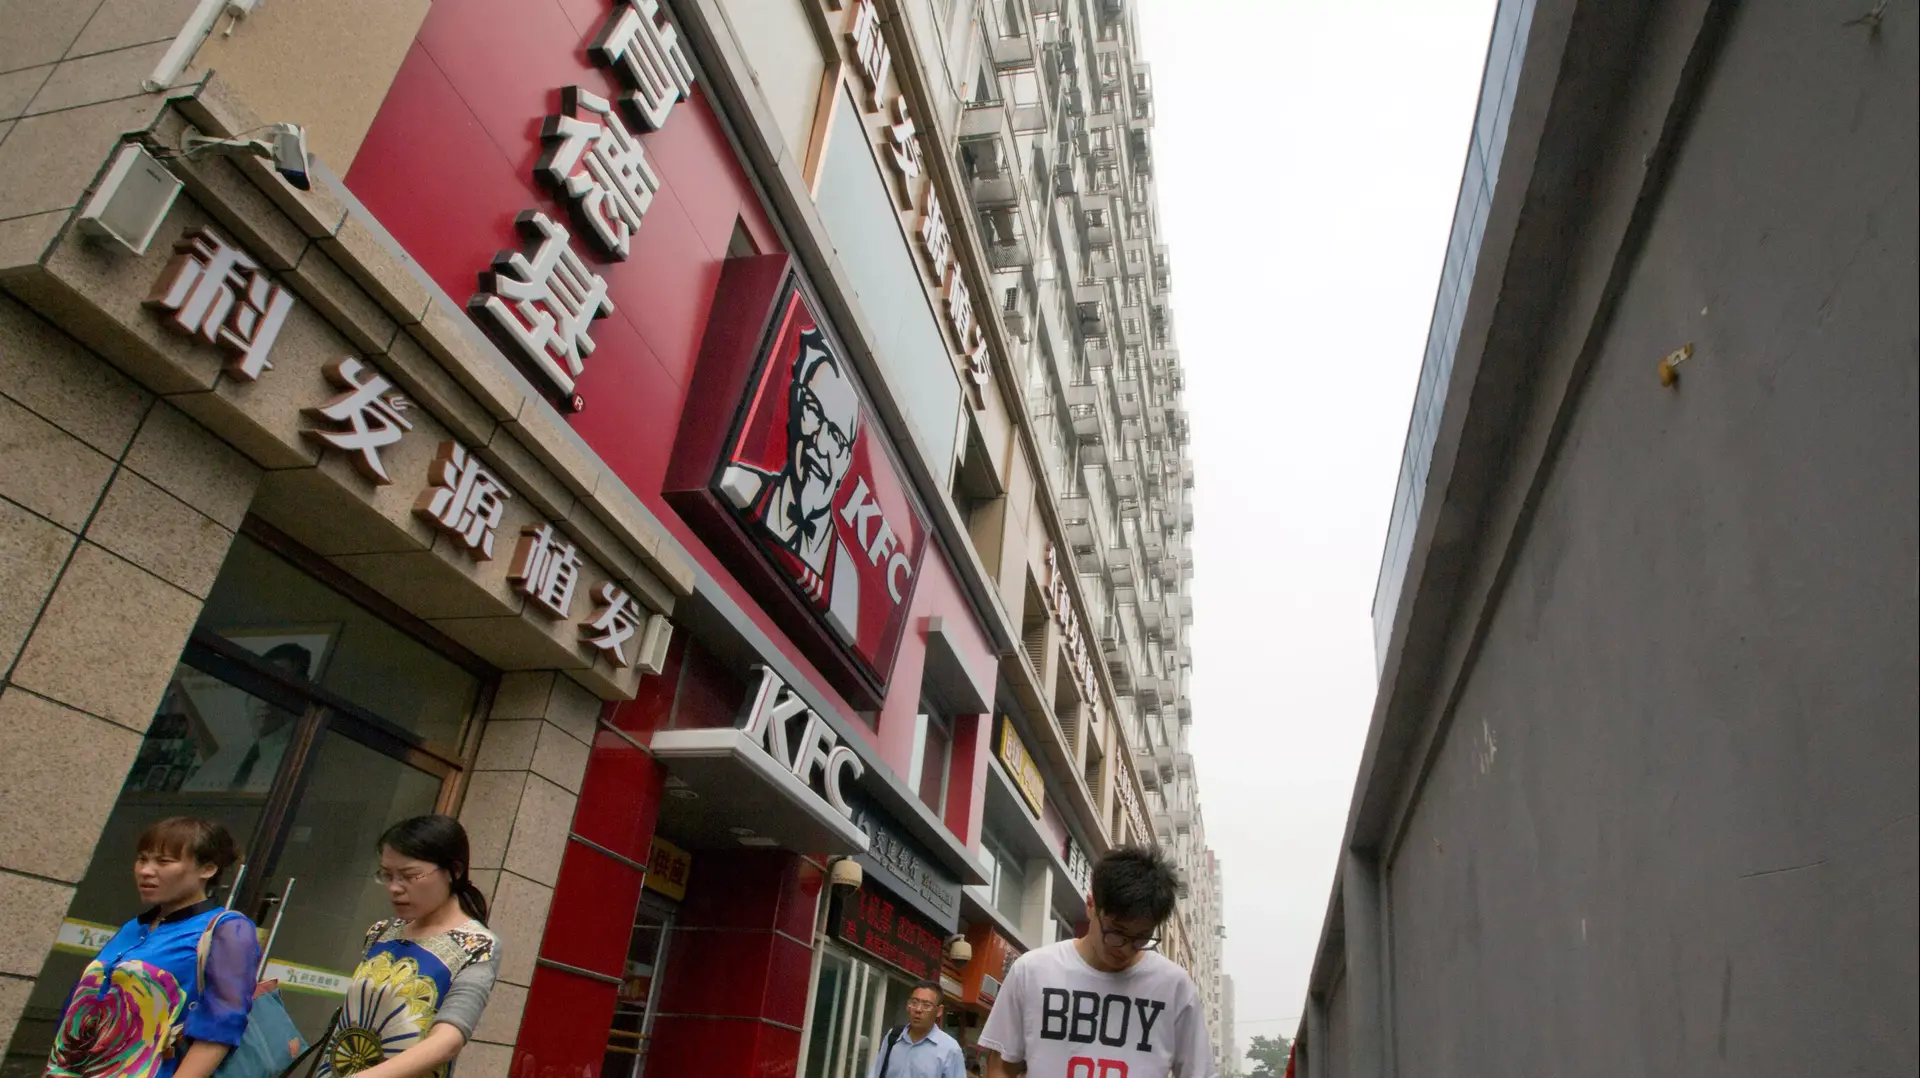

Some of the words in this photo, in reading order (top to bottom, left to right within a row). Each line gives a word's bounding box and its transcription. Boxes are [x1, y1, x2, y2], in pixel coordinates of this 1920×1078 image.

[480, 0, 695, 397] 肯德基
[150, 224, 641, 668] 科发源植发
[840, 475, 912, 605] KFC
[741, 665, 865, 819] KFC
[1040, 988, 1165, 1052] BBOY
